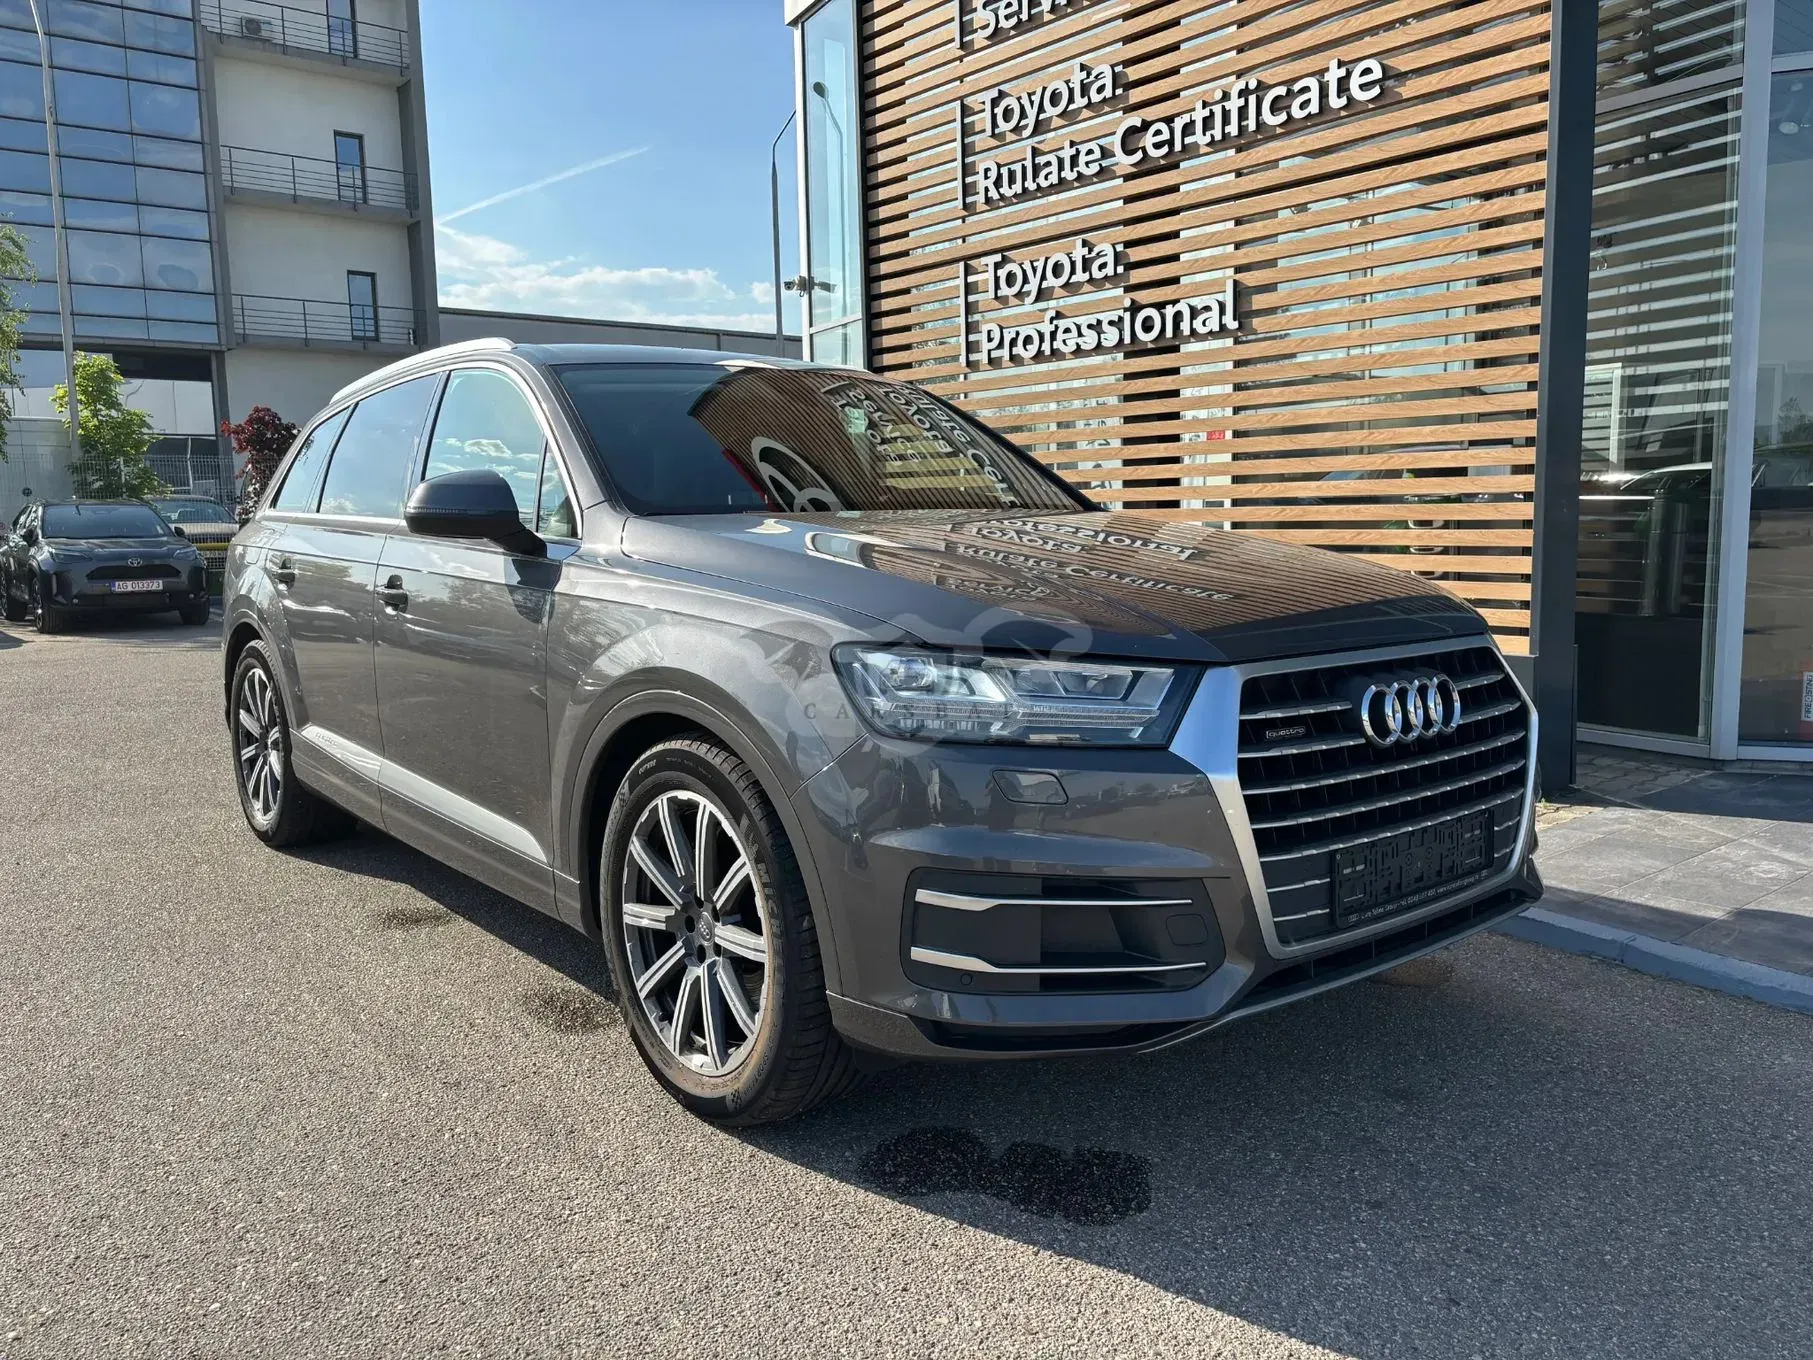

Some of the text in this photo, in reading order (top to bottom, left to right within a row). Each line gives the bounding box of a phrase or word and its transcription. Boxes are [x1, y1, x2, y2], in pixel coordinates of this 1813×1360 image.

[978, 60, 1113, 138] Toyota
[979, 58, 1383, 203] Rulate Certificate
[981, 239, 1116, 305] Toyota
[982, 279, 1239, 364] Professional
[117, 582, 129, 590] AG
